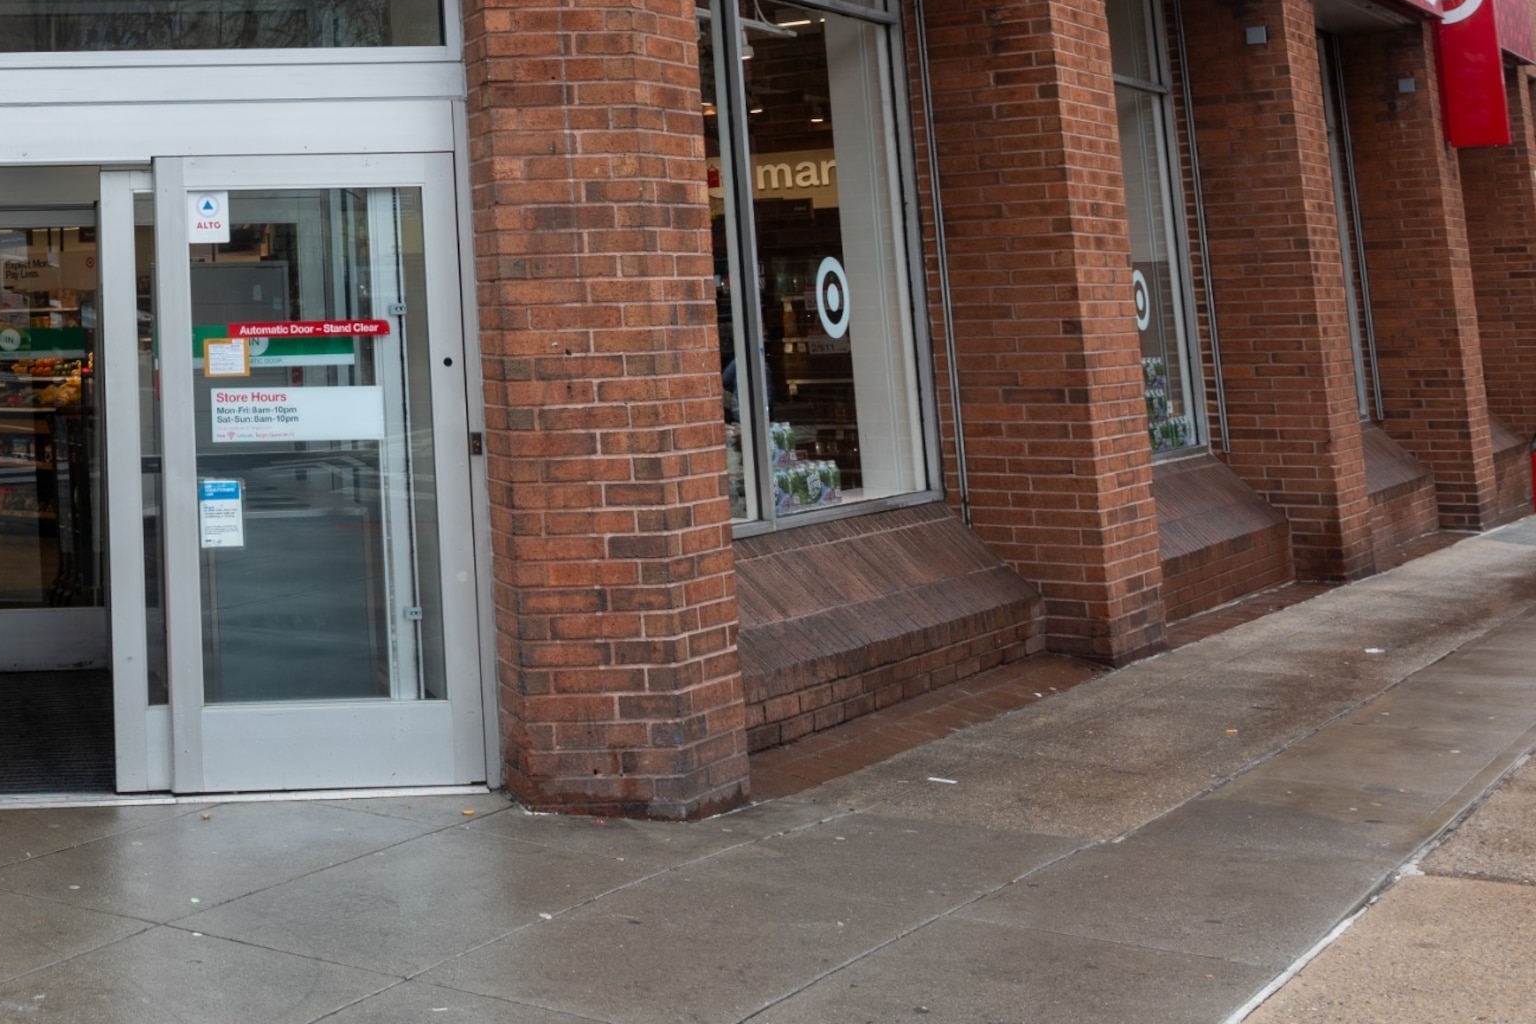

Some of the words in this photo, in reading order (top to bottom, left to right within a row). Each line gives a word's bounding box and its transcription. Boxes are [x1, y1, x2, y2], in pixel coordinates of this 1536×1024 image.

[32, 260, 54, 268] Mor
[5, 271, 18, 280] Pay
[239, 325, 289, 335] Automatic
[291, 324, 314, 334] Door
[323, 323, 351, 333] Stand
[353, 322, 378, 332] Clear
[216, 393, 248, 403] Store
[251, 392, 287, 402] Hours
[216, 406, 250, 414] Mon-Fri:
[216, 415, 253, 424] Sat-Sun:
